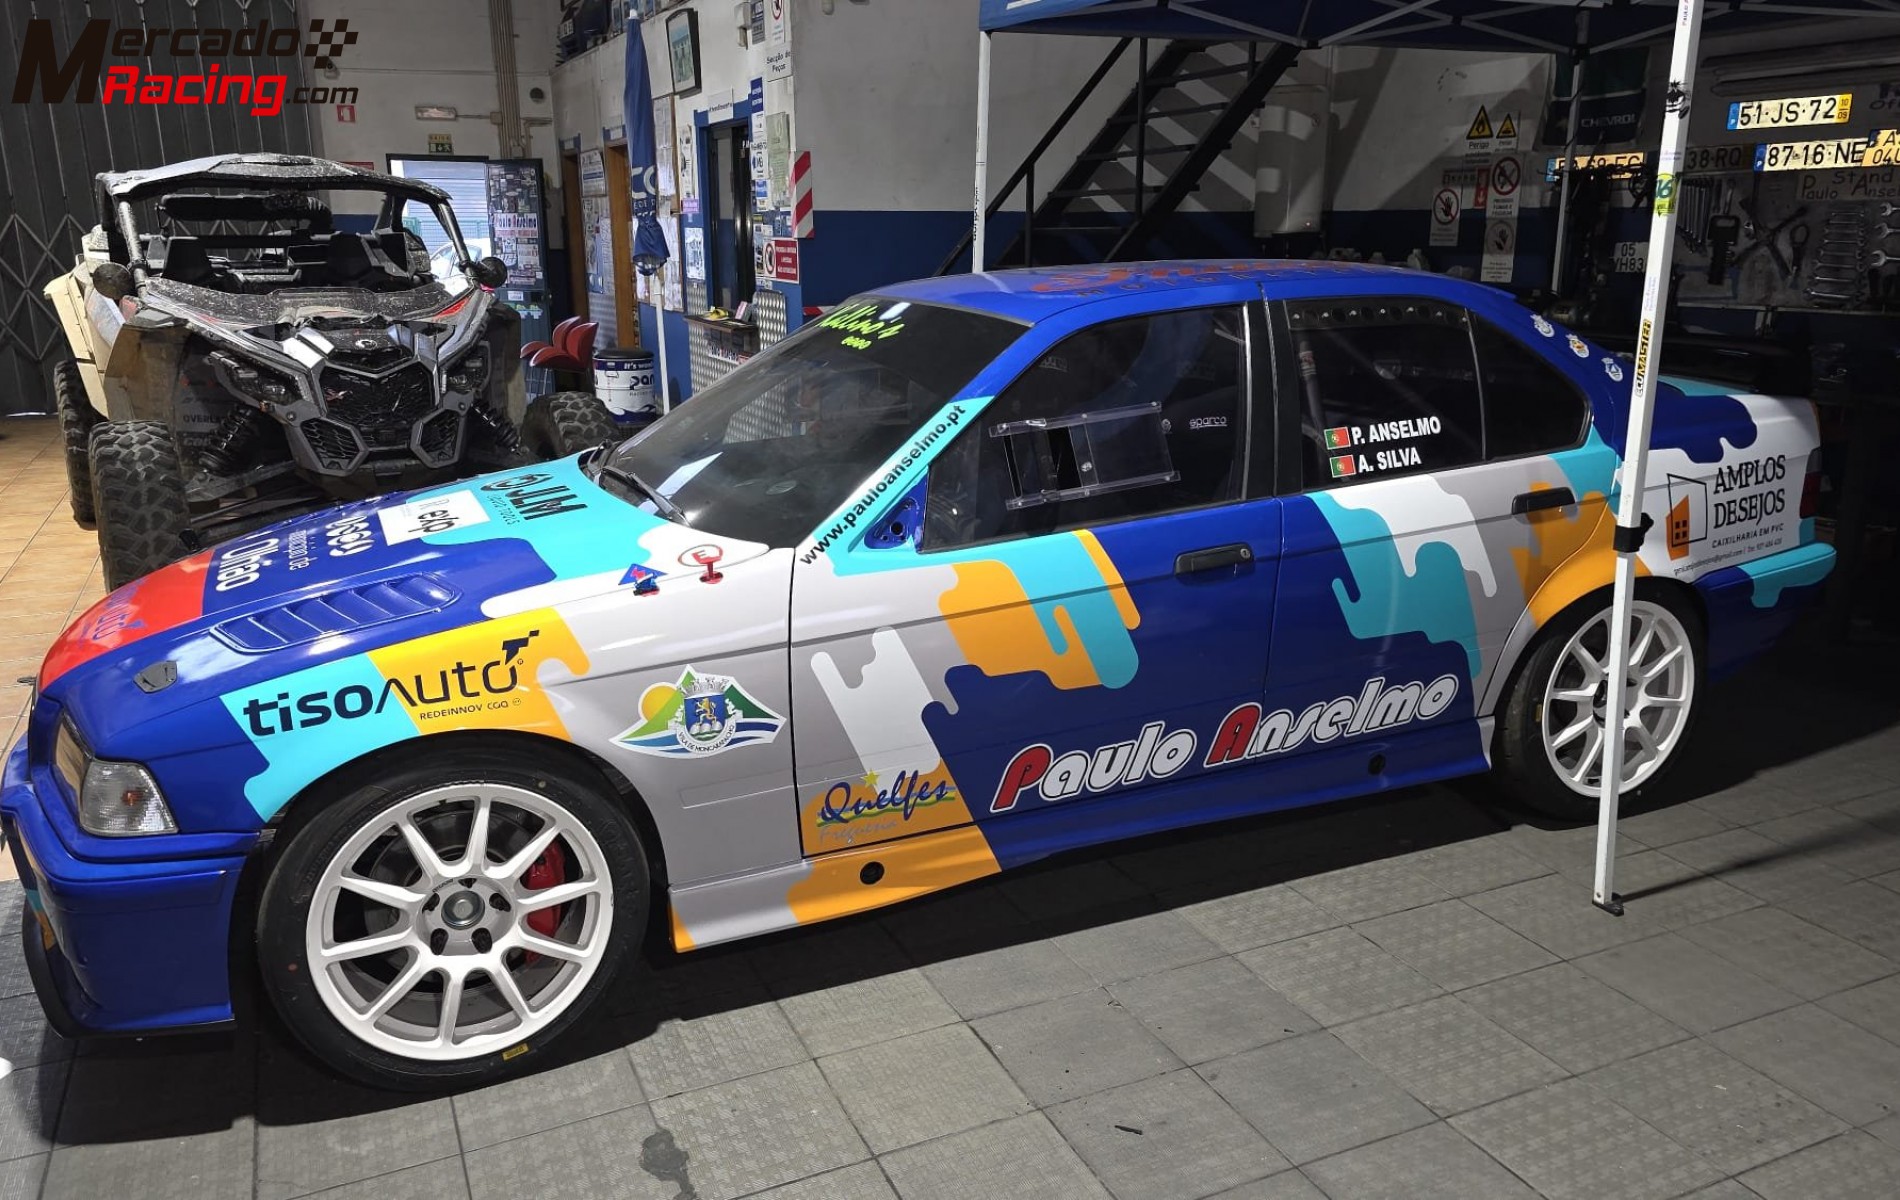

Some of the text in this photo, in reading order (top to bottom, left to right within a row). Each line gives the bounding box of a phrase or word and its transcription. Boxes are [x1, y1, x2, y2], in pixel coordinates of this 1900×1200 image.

[1621, 243, 1636, 257] 05
[1189, 415, 1228, 430] sparco
[1351, 416, 1442, 445] P. ANSELMO
[1357, 447, 1422, 473] A. SILVA
[1713, 455, 1786, 494] AMPLOS
[800, 404, 966, 565] www.pauloanselmo.pt
[1713, 488, 1786, 529] DESEJOS
[1712, 530, 1758, 548] CAIXILHARIA
[1759, 527, 1770, 537] EM
[1771, 523, 1784, 532] PVC
[420, 703, 483, 720] REDEINNOV
[990, 673, 1459, 813] Paulo Anselmo
[821, 770, 949, 823] Quelfes
